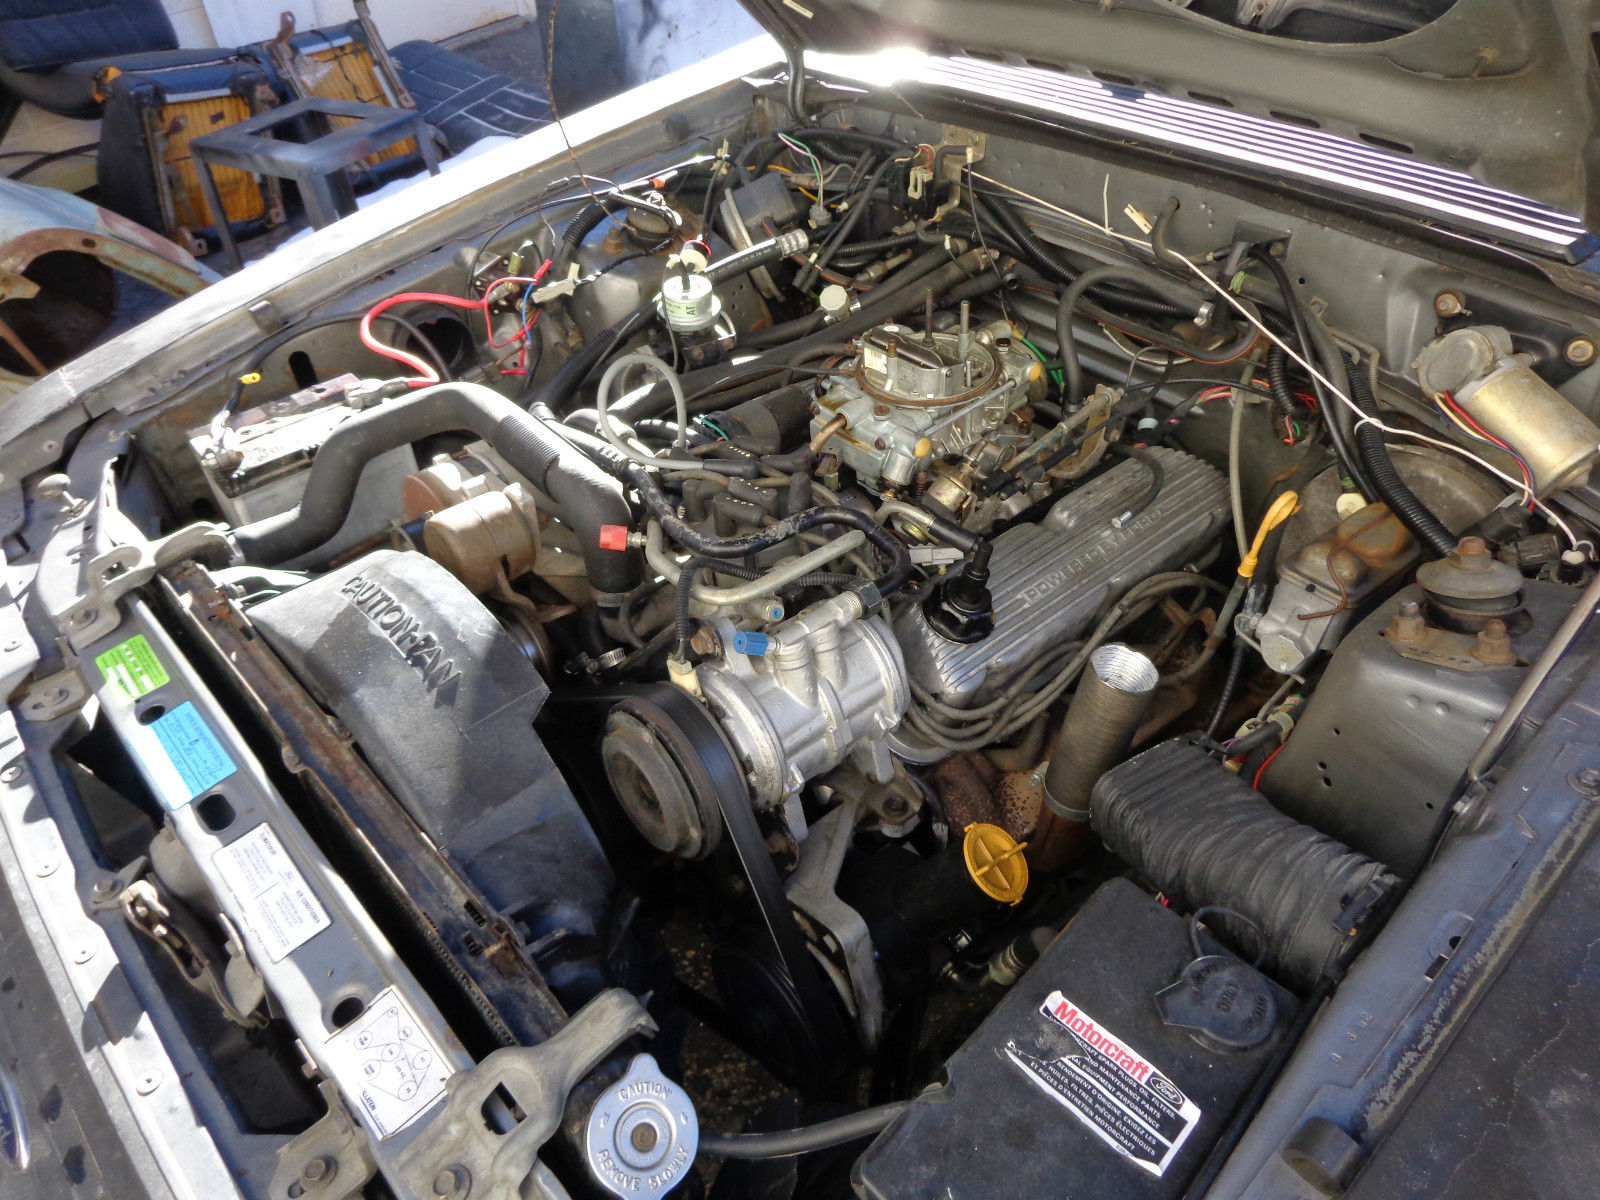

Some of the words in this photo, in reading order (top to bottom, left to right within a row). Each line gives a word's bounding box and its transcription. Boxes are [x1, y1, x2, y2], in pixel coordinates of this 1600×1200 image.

[1054, 1001, 1149, 1081] Motorcraft
[1153, 1079, 1179, 1102] Ford
[1097, 1053, 1118, 1071] SPARK
[616, 1080, 672, 1102] CAUTION
[1029, 1060, 1039, 1070] ET
[1056, 1083, 1095, 1117] D'ENTRETIEN
[1092, 1113, 1136, 1151] MOTORCRAFT
[1055, 1060, 1092, 1091] RENDEMENT
[1122, 1115, 1145, 1135] EXIGEZ
[1143, 1132, 1158, 1145] LES
[1081, 1063, 1117, 1093] EQUIPMENT
[1115, 1090, 1161, 1130] PERFORMANCE
[1098, 1065, 1141, 1102] MAINTENANCE
[1140, 1099, 1162, 1119] PARTS
[597, 1147, 642, 1192] REMOVE
[647, 1144, 690, 1191] SLOWLY
